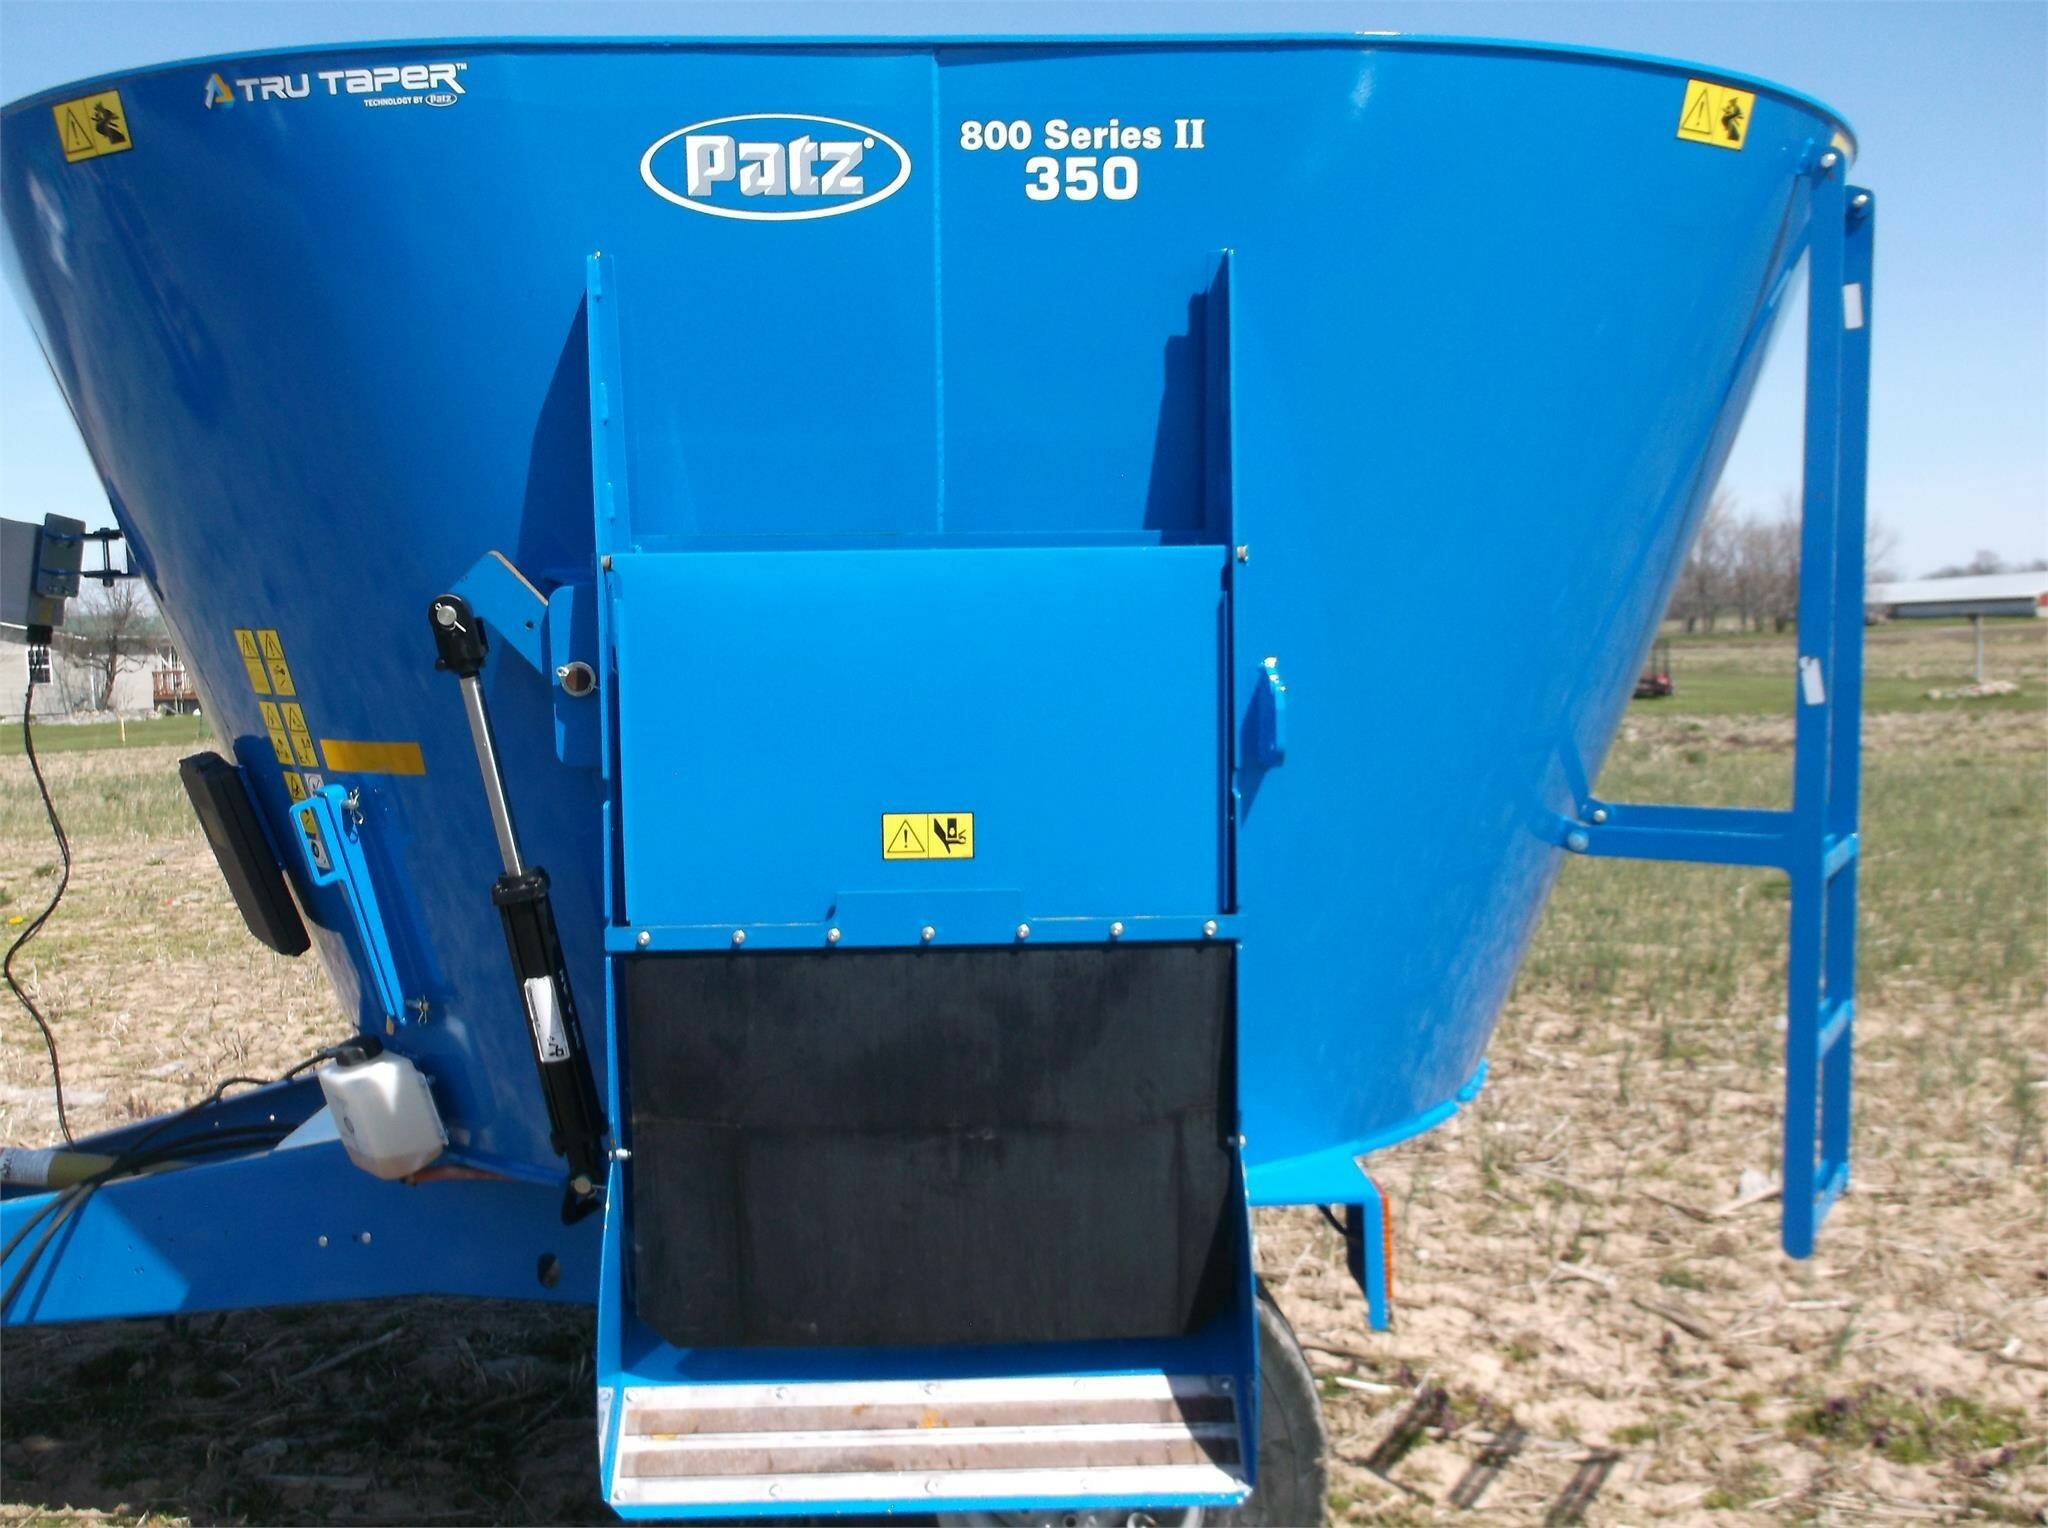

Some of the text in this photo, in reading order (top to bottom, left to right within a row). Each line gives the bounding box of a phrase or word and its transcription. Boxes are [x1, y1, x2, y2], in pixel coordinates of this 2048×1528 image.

[236, 73, 310, 102] TRU
[363, 97, 411, 107] TECHNOLOGY
[412, 96, 423, 105] BY
[960, 118, 1206, 151] 800 Series II
[685, 134, 865, 197] Patz
[1025, 155, 1139, 201] 350
